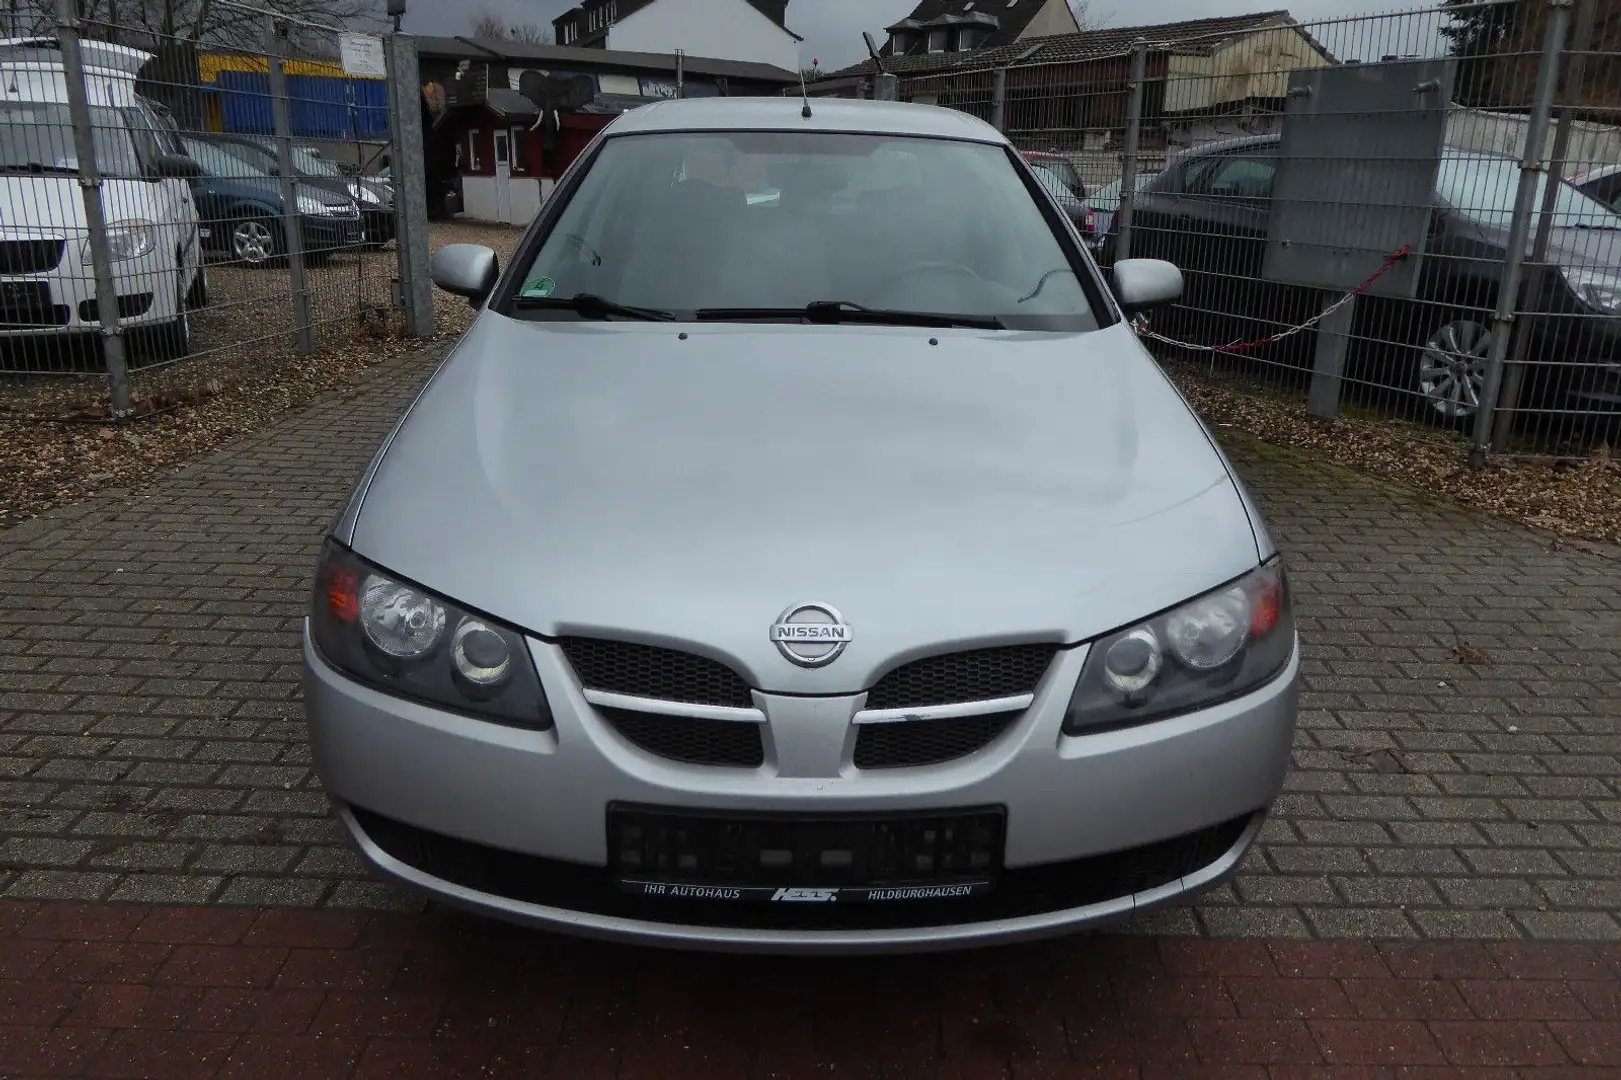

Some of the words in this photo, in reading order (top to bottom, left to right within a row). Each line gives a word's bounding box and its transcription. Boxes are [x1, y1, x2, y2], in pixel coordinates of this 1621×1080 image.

[778, 627, 844, 638] NISSAN
[643, 884, 666, 894] IHR
[670, 886, 741, 899] AUTOHAUS
[867, 885, 972, 900] HILDBURGHAUSEN
